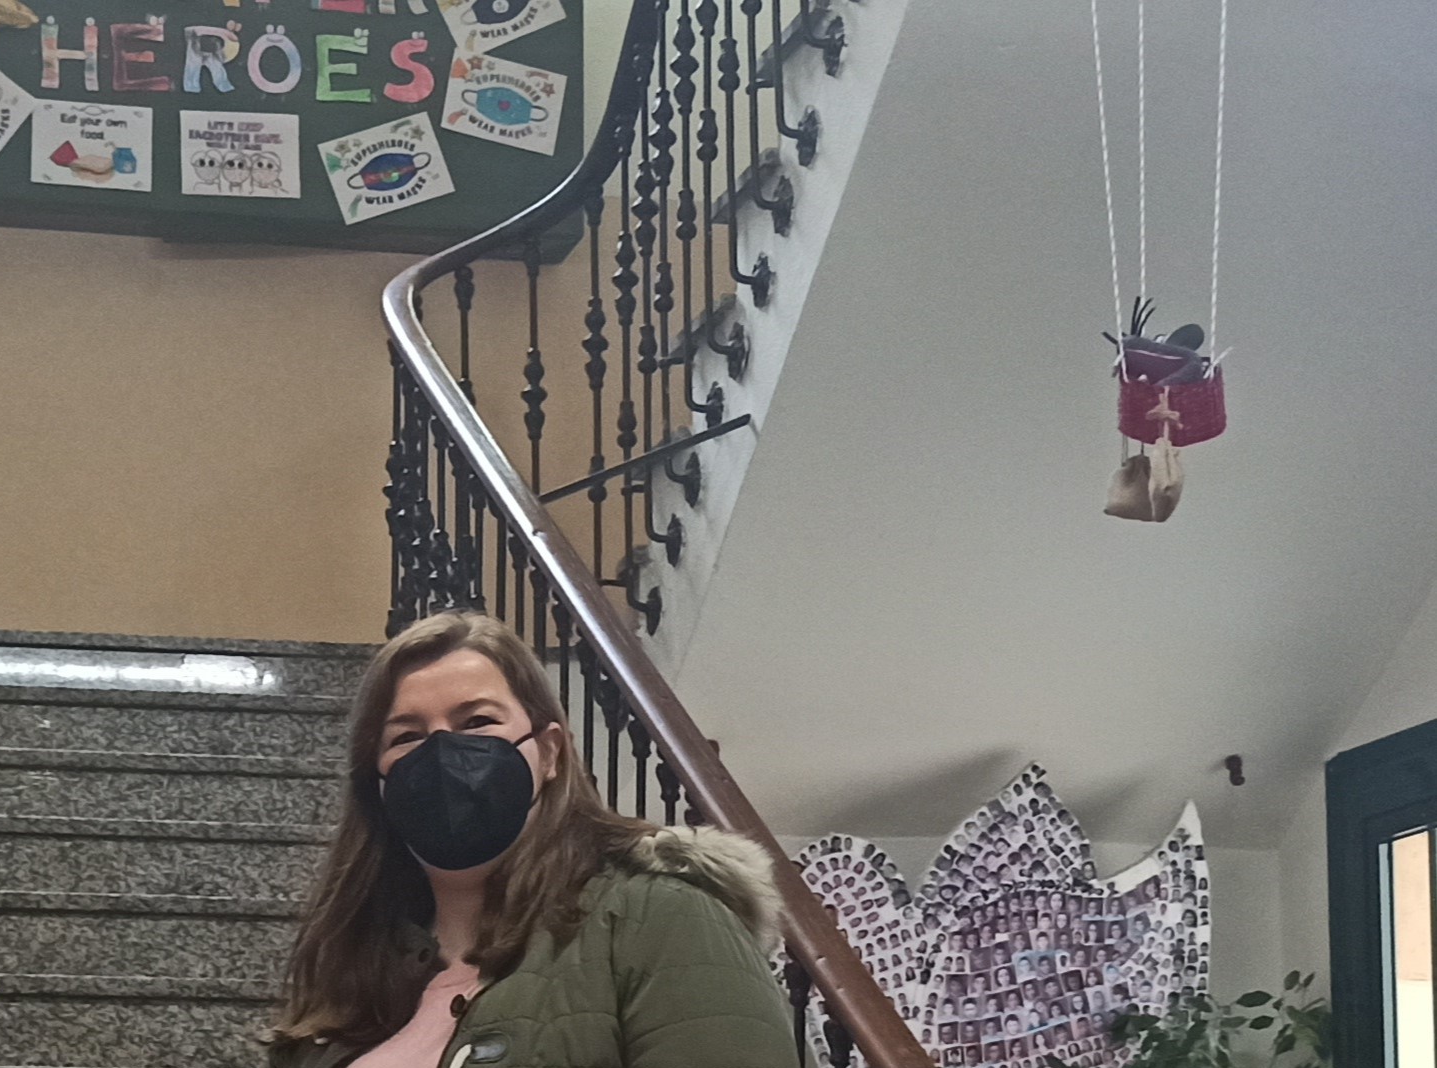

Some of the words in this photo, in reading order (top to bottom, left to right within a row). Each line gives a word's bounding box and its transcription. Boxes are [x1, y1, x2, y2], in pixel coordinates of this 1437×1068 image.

[479, 27, 508, 39] WEAR
[40, 22, 435, 104] HEROES
[105, 118, 128, 128] own
[468, 114, 495, 134] WEAR
[499, 126, 533, 139] MASKS
[349, 138, 416, 168] SUPERHEROES
[364, 195, 395, 206] WEAR
[397, 175, 427, 201] MASKS
